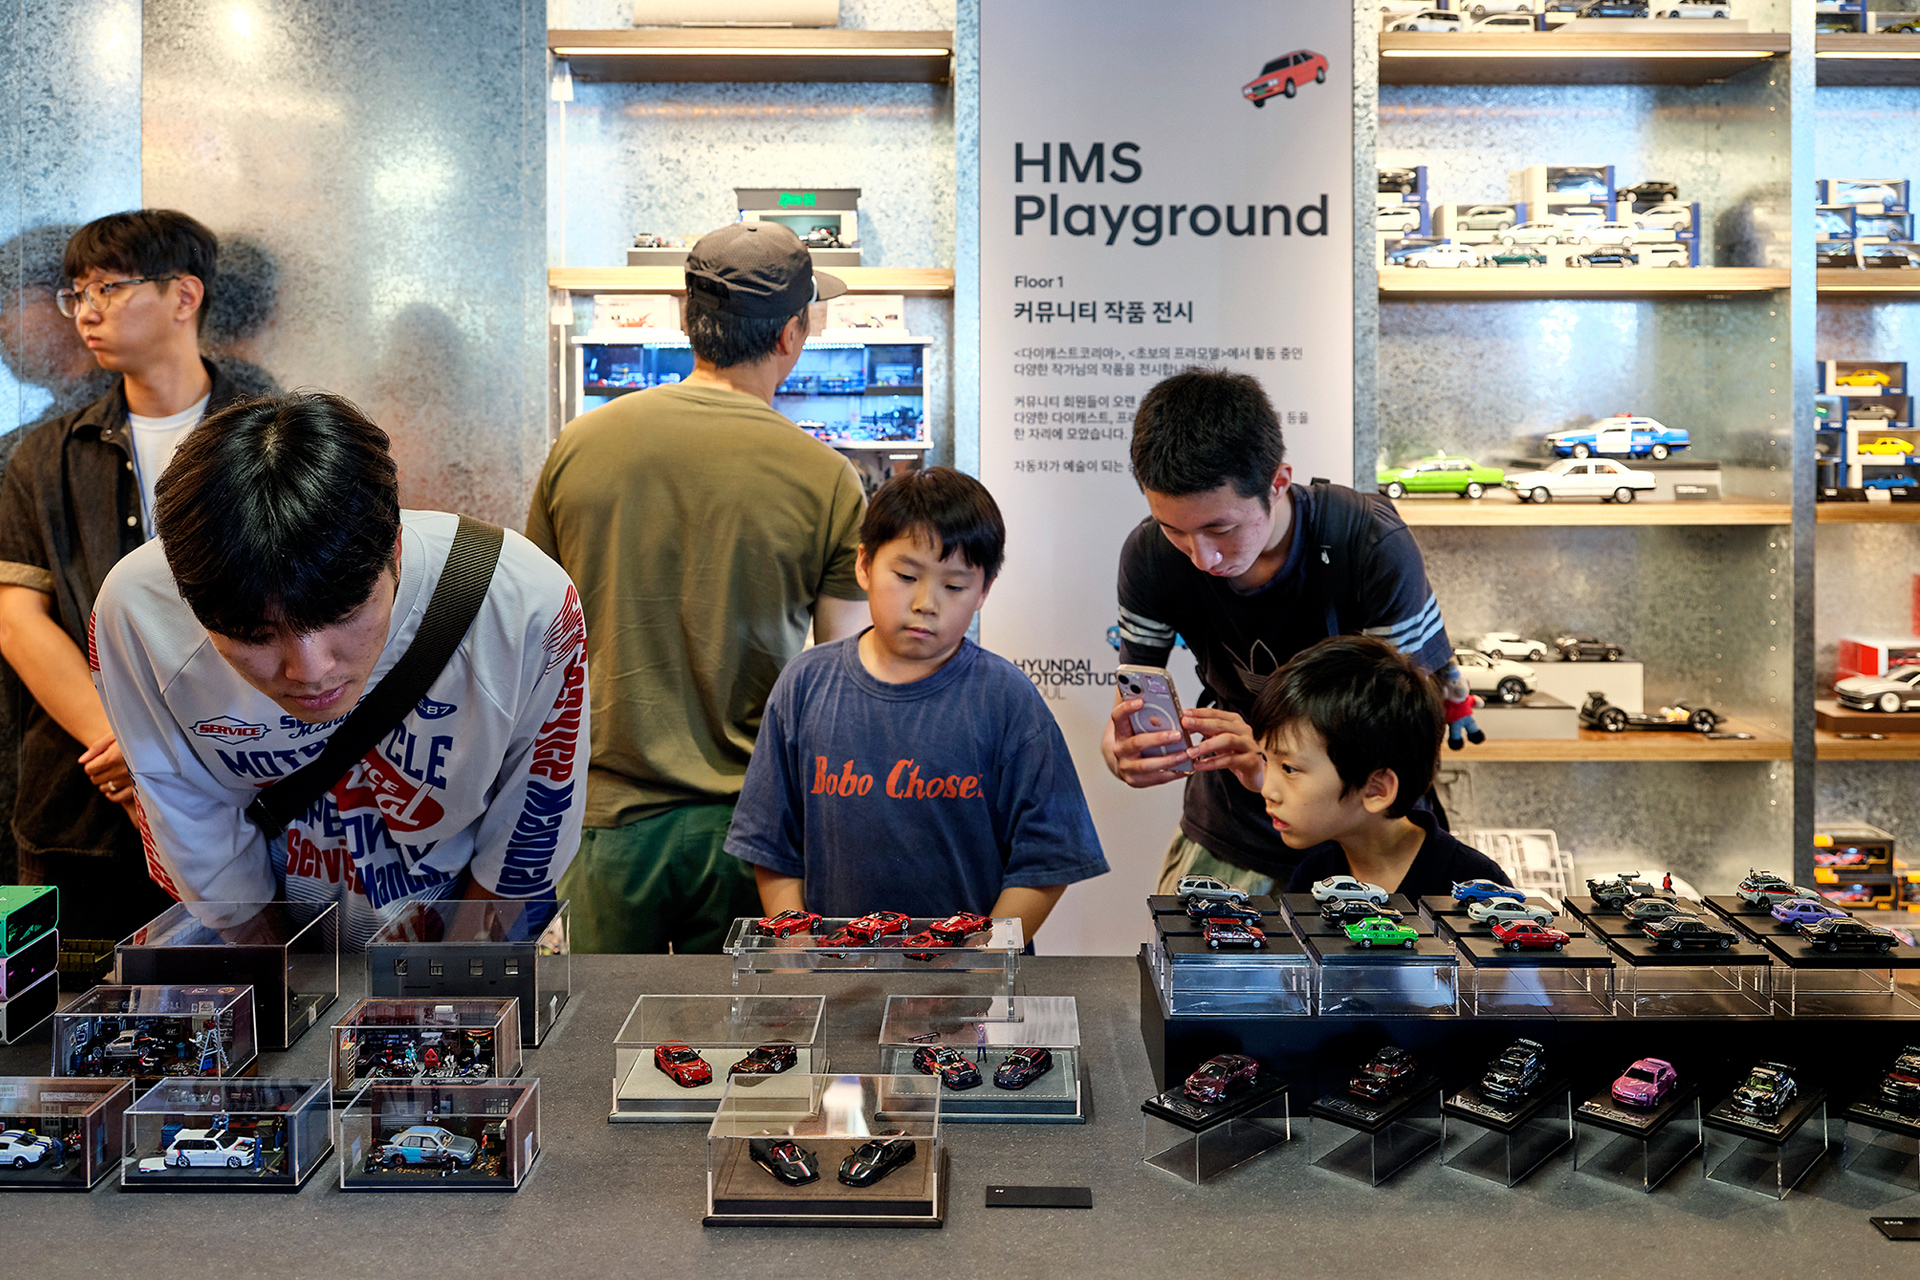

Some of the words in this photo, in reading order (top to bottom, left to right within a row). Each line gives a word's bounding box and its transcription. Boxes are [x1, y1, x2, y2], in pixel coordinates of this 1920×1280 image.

[1015, 141, 1143, 184] HMS
[1014, 193, 1330, 247] Playground
[1014, 274, 1054, 289] Floor
[1057, 275, 1064, 288] 1
[1014, 301, 1098, 324] 커뮤니티
[1104, 301, 1146, 324] 작품
[1152, 301, 1194, 324] 전시
[1254, 347, 1275, 360] 활동
[1280, 347, 1303, 360] 중인
[1014, 363, 1048, 376] 다양한
[1052, 363, 1098, 376] 작가님의
[1101, 363, 1135, 376] 작품을
[1014, 395, 1060, 408] 커뮤니티
[1063, 395, 1109, 408] 회원들이
[1014, 411, 1048, 424] 다양한
[1014, 428, 1025, 440] 한
[1029, 428, 1063, 440] 자리에
[1067, 428, 1127, 440] 모았습니다.
[1014, 460, 1060, 473] 자동차가
[1063, 460, 1098, 473] 예술이
[1101, 460, 1124, 473] 되는
[1014, 659, 1091, 672] HYUNDAI
[1028, 672, 1117, 686] OTORSTUD
[198, 723, 262, 737] SERVICE
[810, 756, 874, 797] Bobo
[494, 778, 576, 898] Manual
